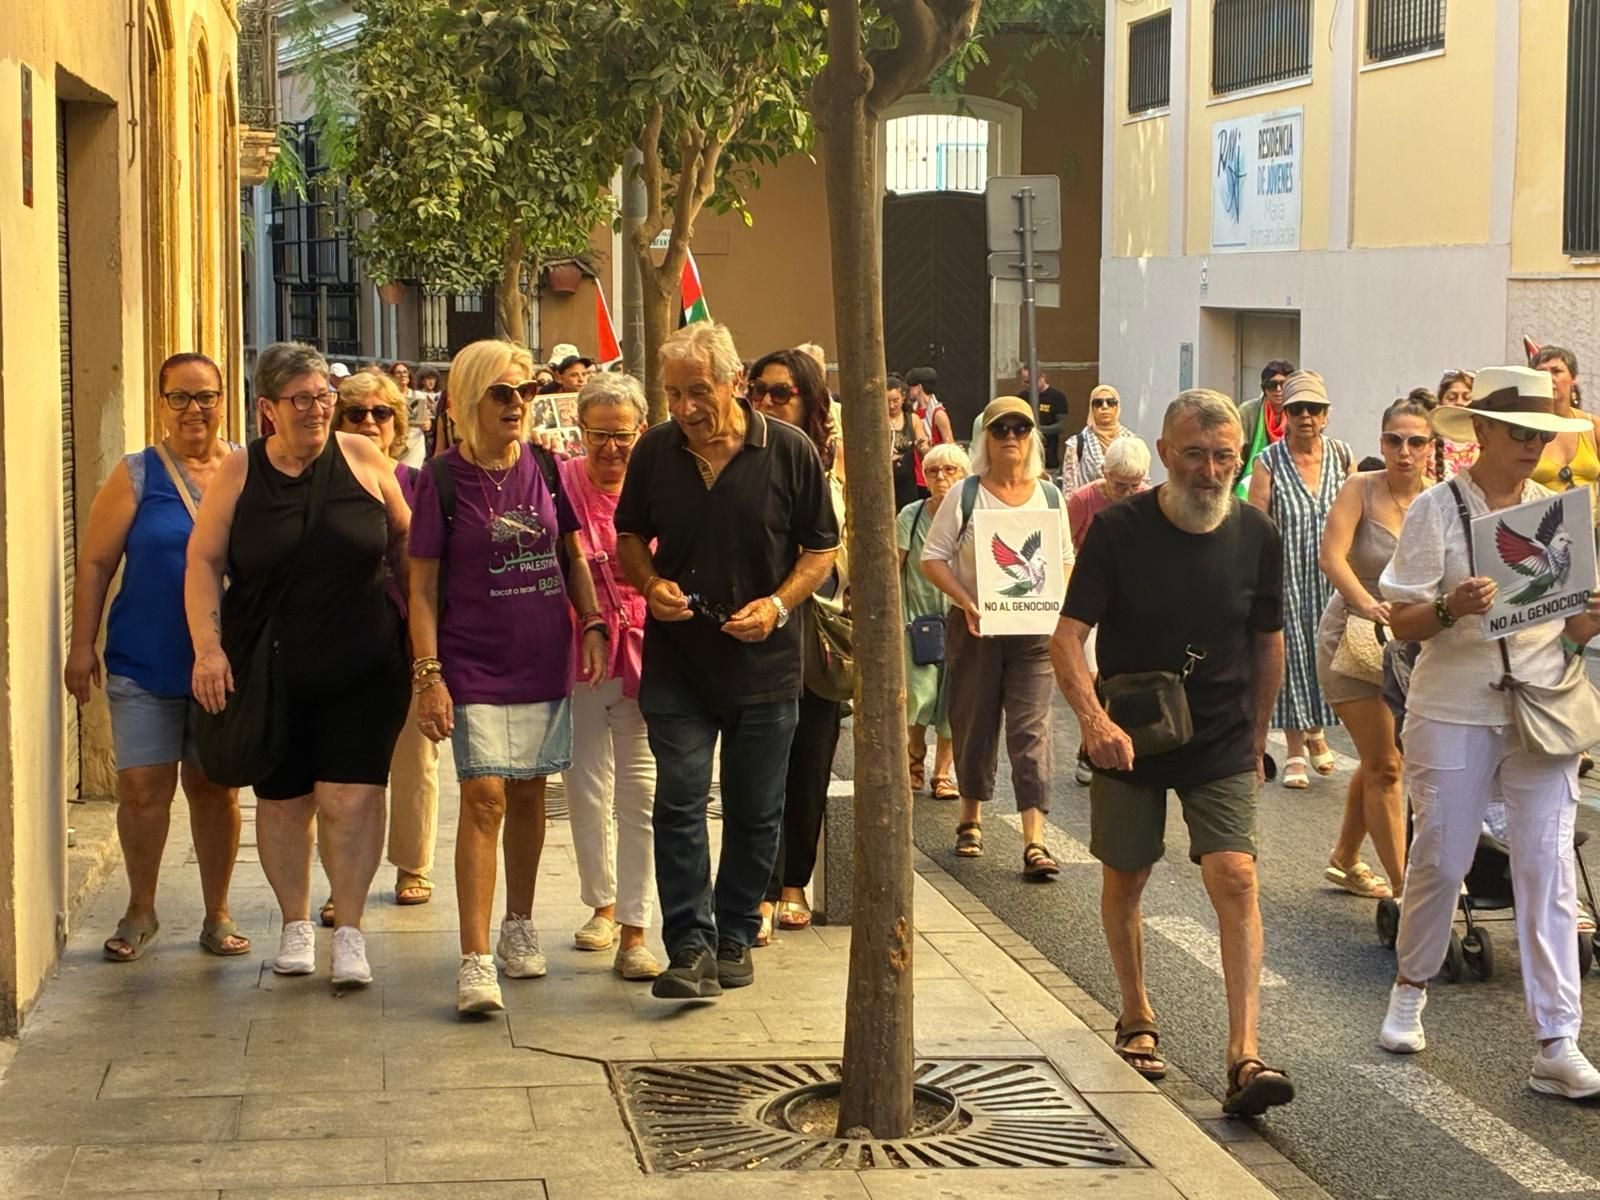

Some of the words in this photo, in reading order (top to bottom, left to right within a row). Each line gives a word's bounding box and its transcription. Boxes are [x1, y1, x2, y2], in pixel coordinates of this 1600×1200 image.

[1258, 123, 1293, 160] RESIDENCIA
[1257, 165, 1266, 195] DE
[984, 601, 998, 612] NO
[1000, 601, 1011, 612] AL
[1012, 601, 1060, 612] GENOCIDIO
[1490, 616, 1507, 633] NO
[1510, 611, 1526, 627] AL
[1527, 589, 1590, 621] GENOCIDIO
